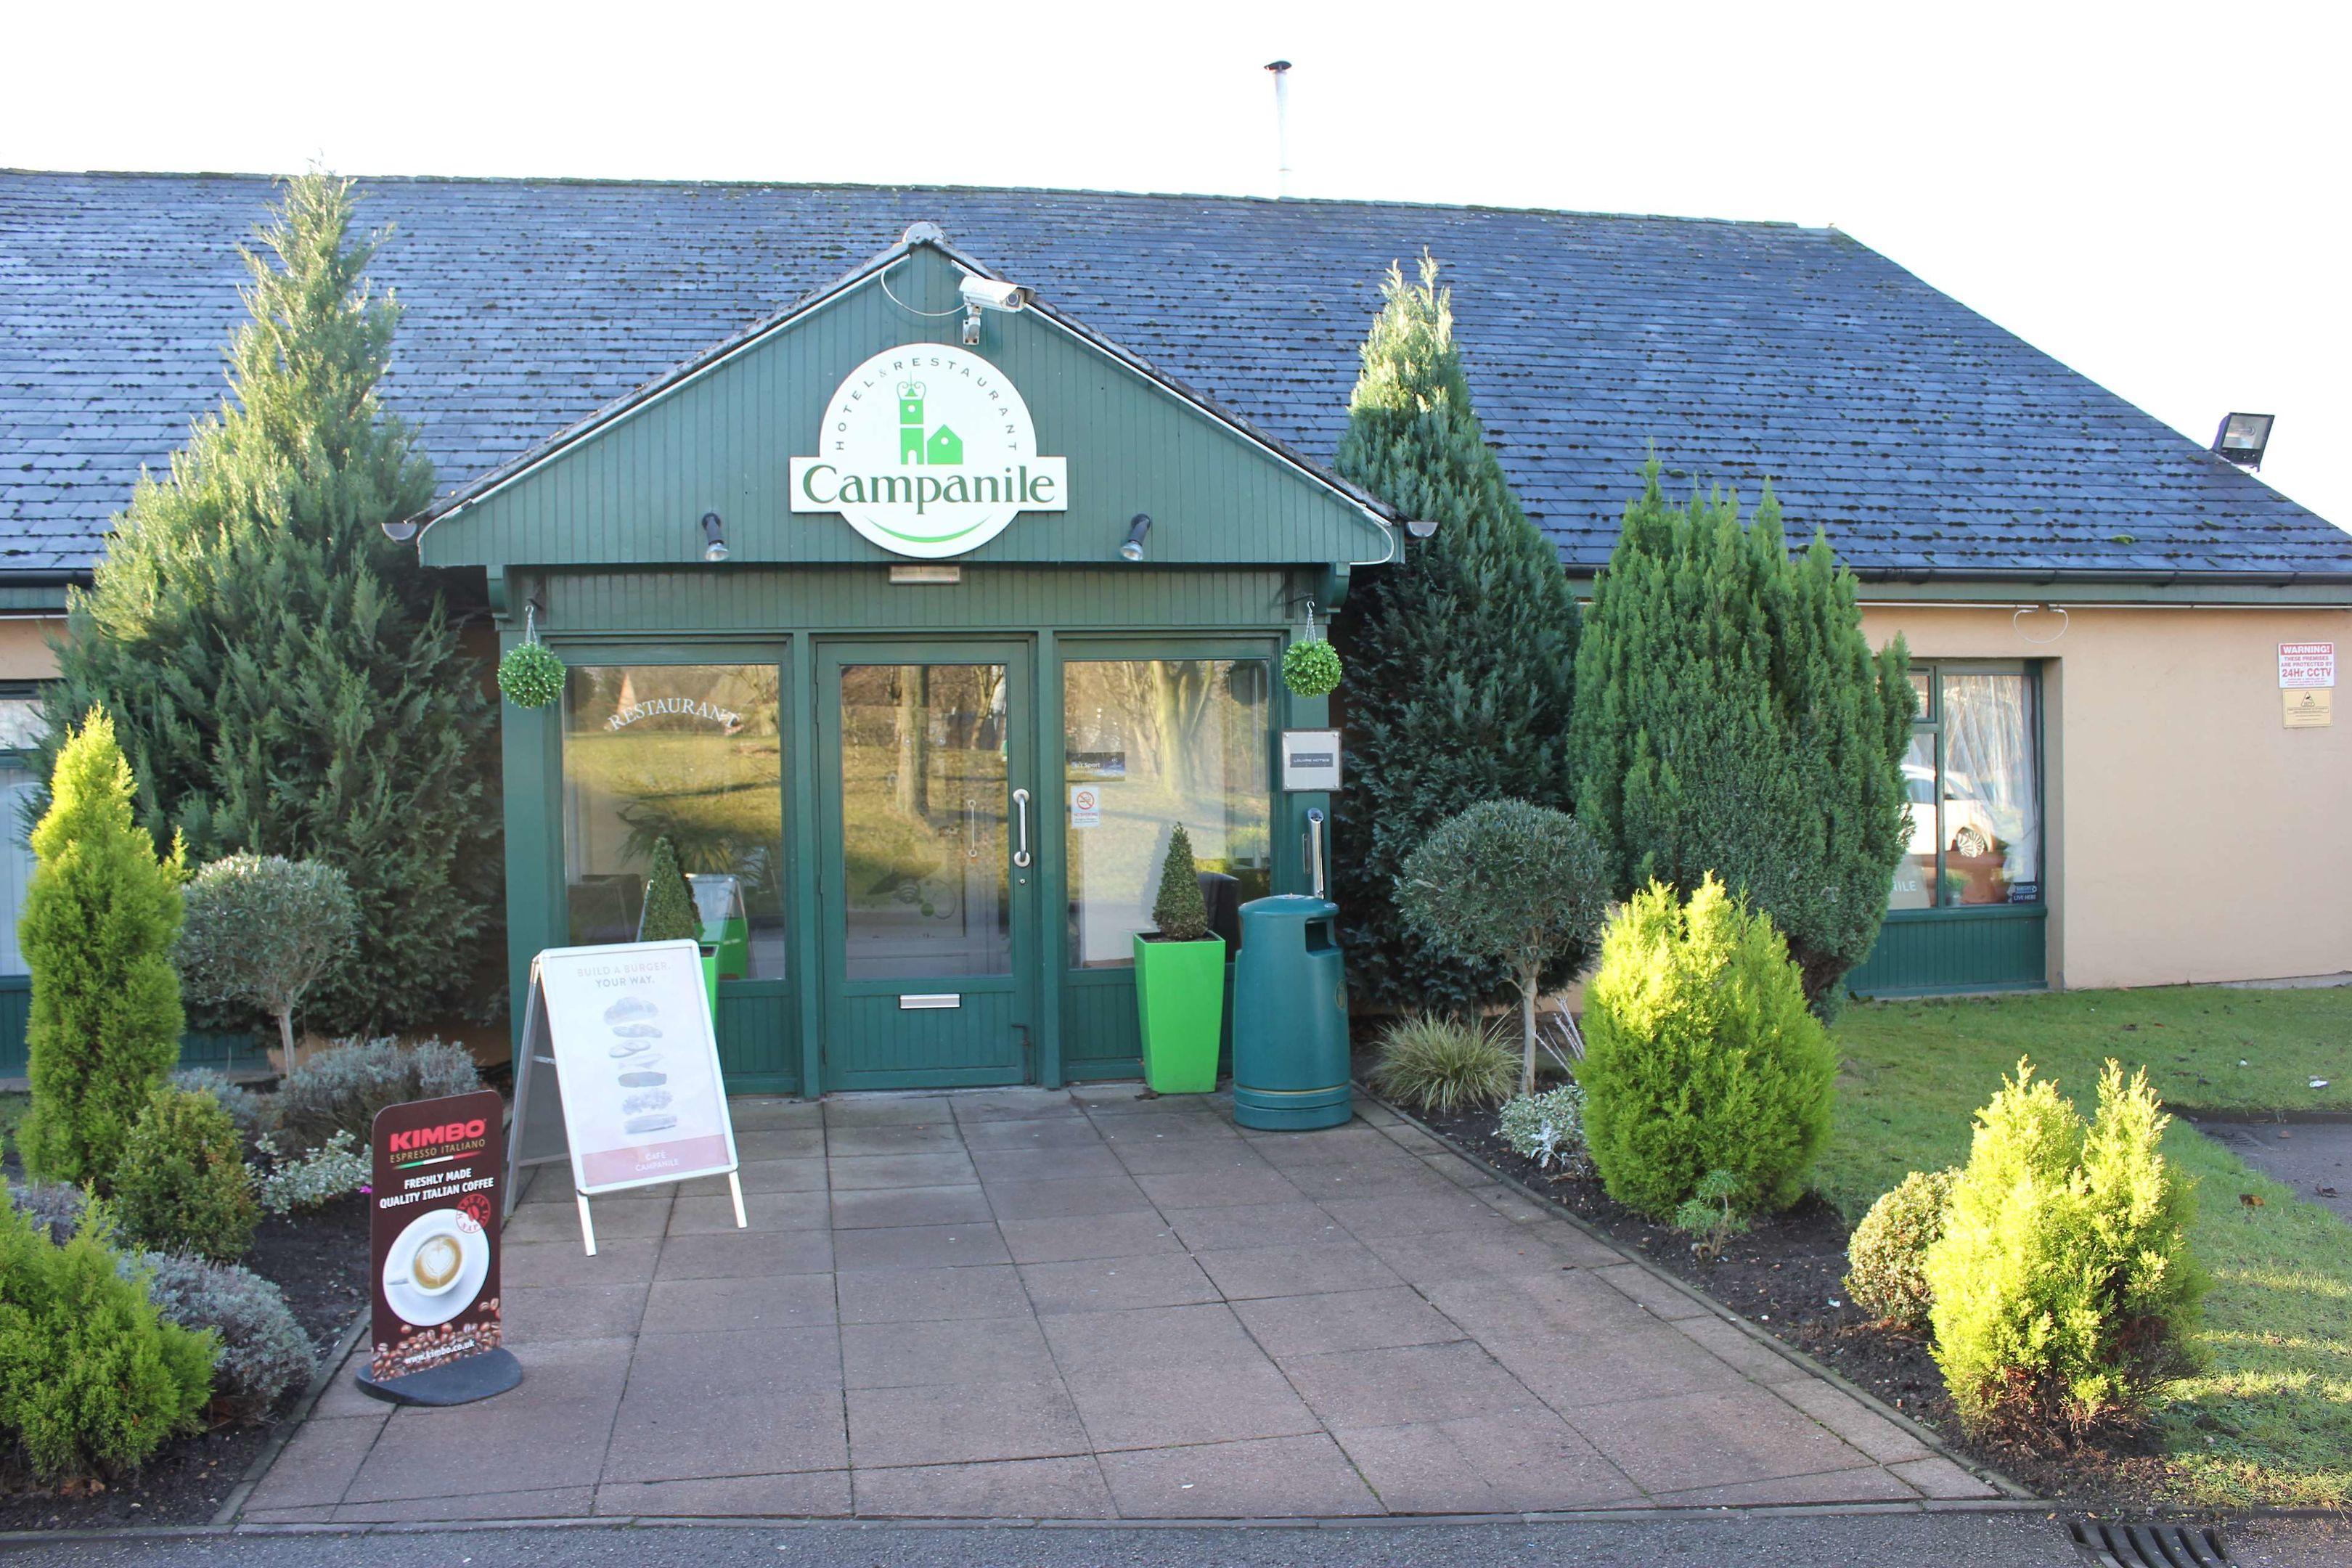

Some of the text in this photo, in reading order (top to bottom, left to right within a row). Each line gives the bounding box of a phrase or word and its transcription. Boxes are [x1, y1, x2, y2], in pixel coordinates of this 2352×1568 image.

[835, 380, 874, 451] HOTEL
[893, 357, 1017, 452] RESTAURANT
[802, 465, 1055, 515] Campanile
[2282, 645, 2330, 654] WARNING!
[2282, 668, 2332, 677] 24Hr CCTV
[608, 698, 741, 730] RESTAURANT
[577, 966, 611, 976] BUILD
[624, 961, 671, 973] BURGER.
[595, 975, 655, 988] YOUR WAY.
[390, 1119, 485, 1152] KIMBO
[390, 1138, 486, 1163] ESPRESSO ITALIANO
[404, 1167, 472, 1190] FRESHLY MADE
[379, 1177, 494, 1209] QUALITY ITALIAN COFFEE
[403, 1339, 475, 1364] www.kimbo.co.uk
